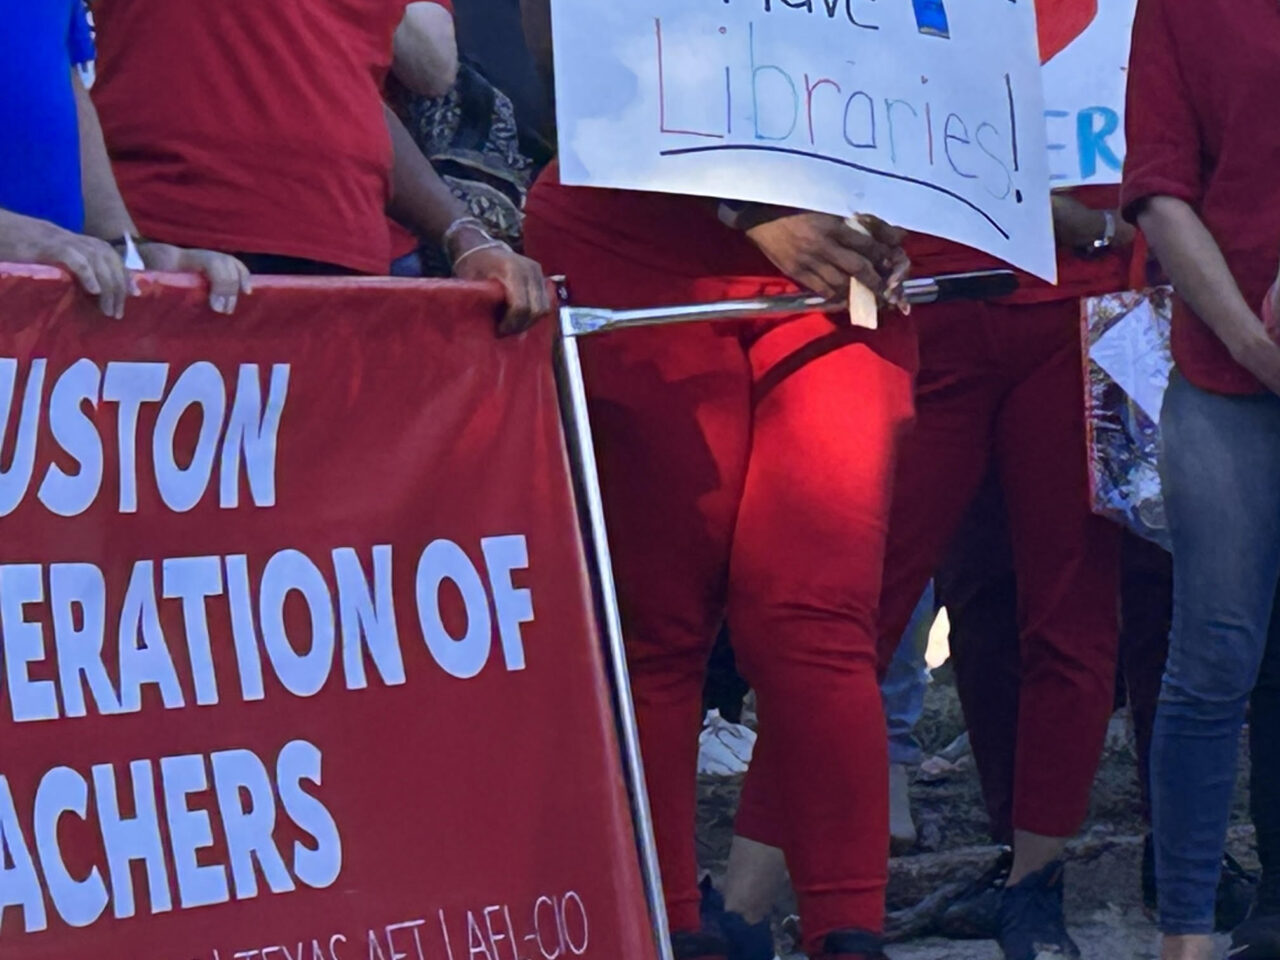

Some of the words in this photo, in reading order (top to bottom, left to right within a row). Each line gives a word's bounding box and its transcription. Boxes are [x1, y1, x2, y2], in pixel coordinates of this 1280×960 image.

[654, 17, 1024, 204] Libraries!
[415, 534, 534, 679] OF
[466, 891, 589, 960] AFL-CIO
